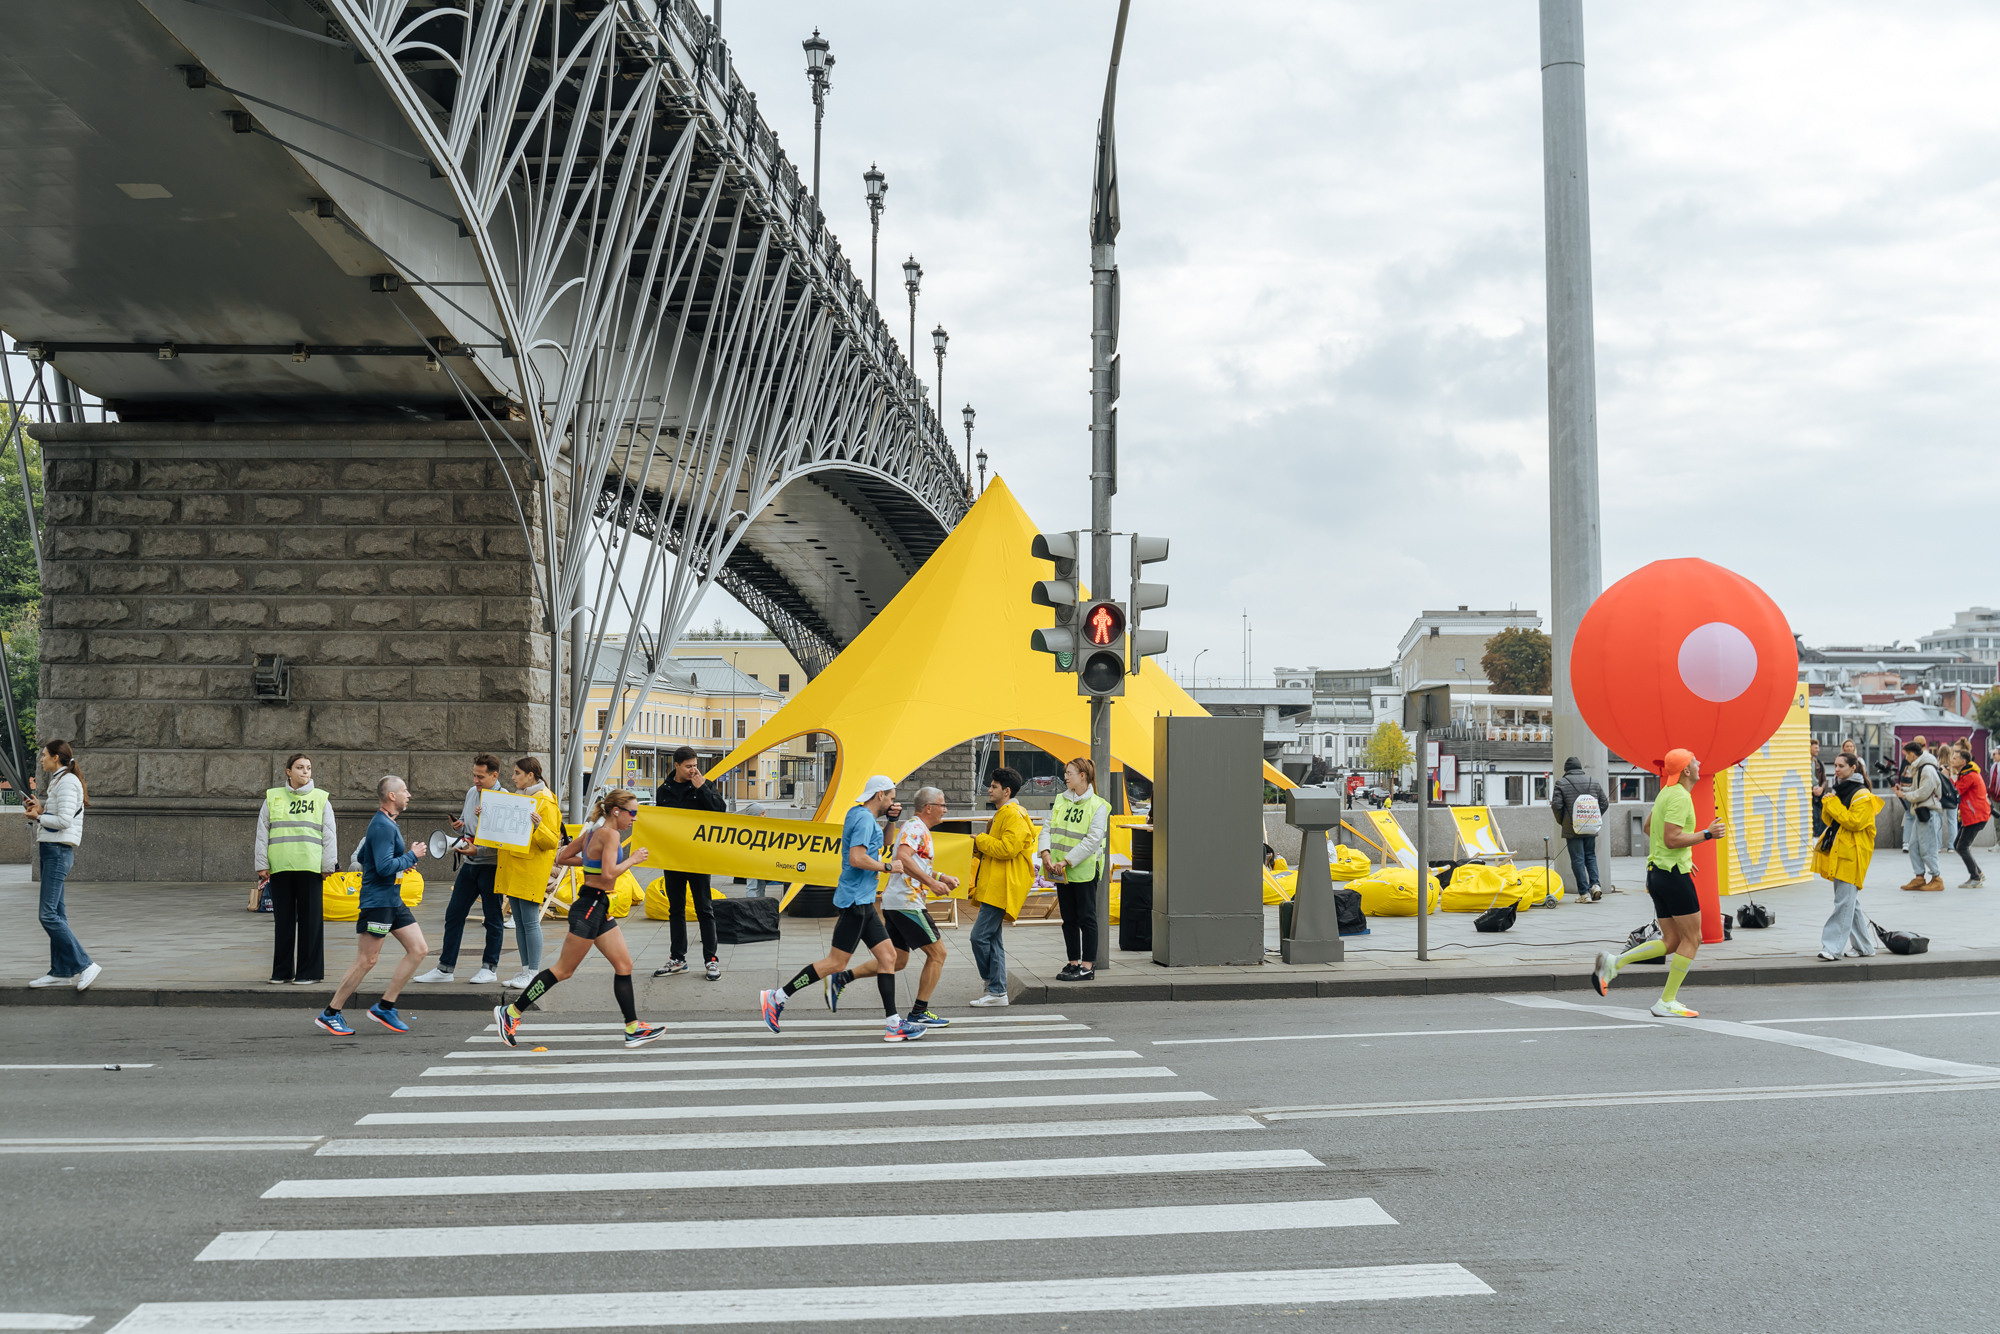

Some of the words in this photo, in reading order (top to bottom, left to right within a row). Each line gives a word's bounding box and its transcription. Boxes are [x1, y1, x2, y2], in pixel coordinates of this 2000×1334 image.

[289, 800, 314, 814] 2254
[693, 824, 843, 855] АПЛОДИРУЕМ
[775, 861, 795, 870] Яндекс
[797, 862, 806, 872] Go
